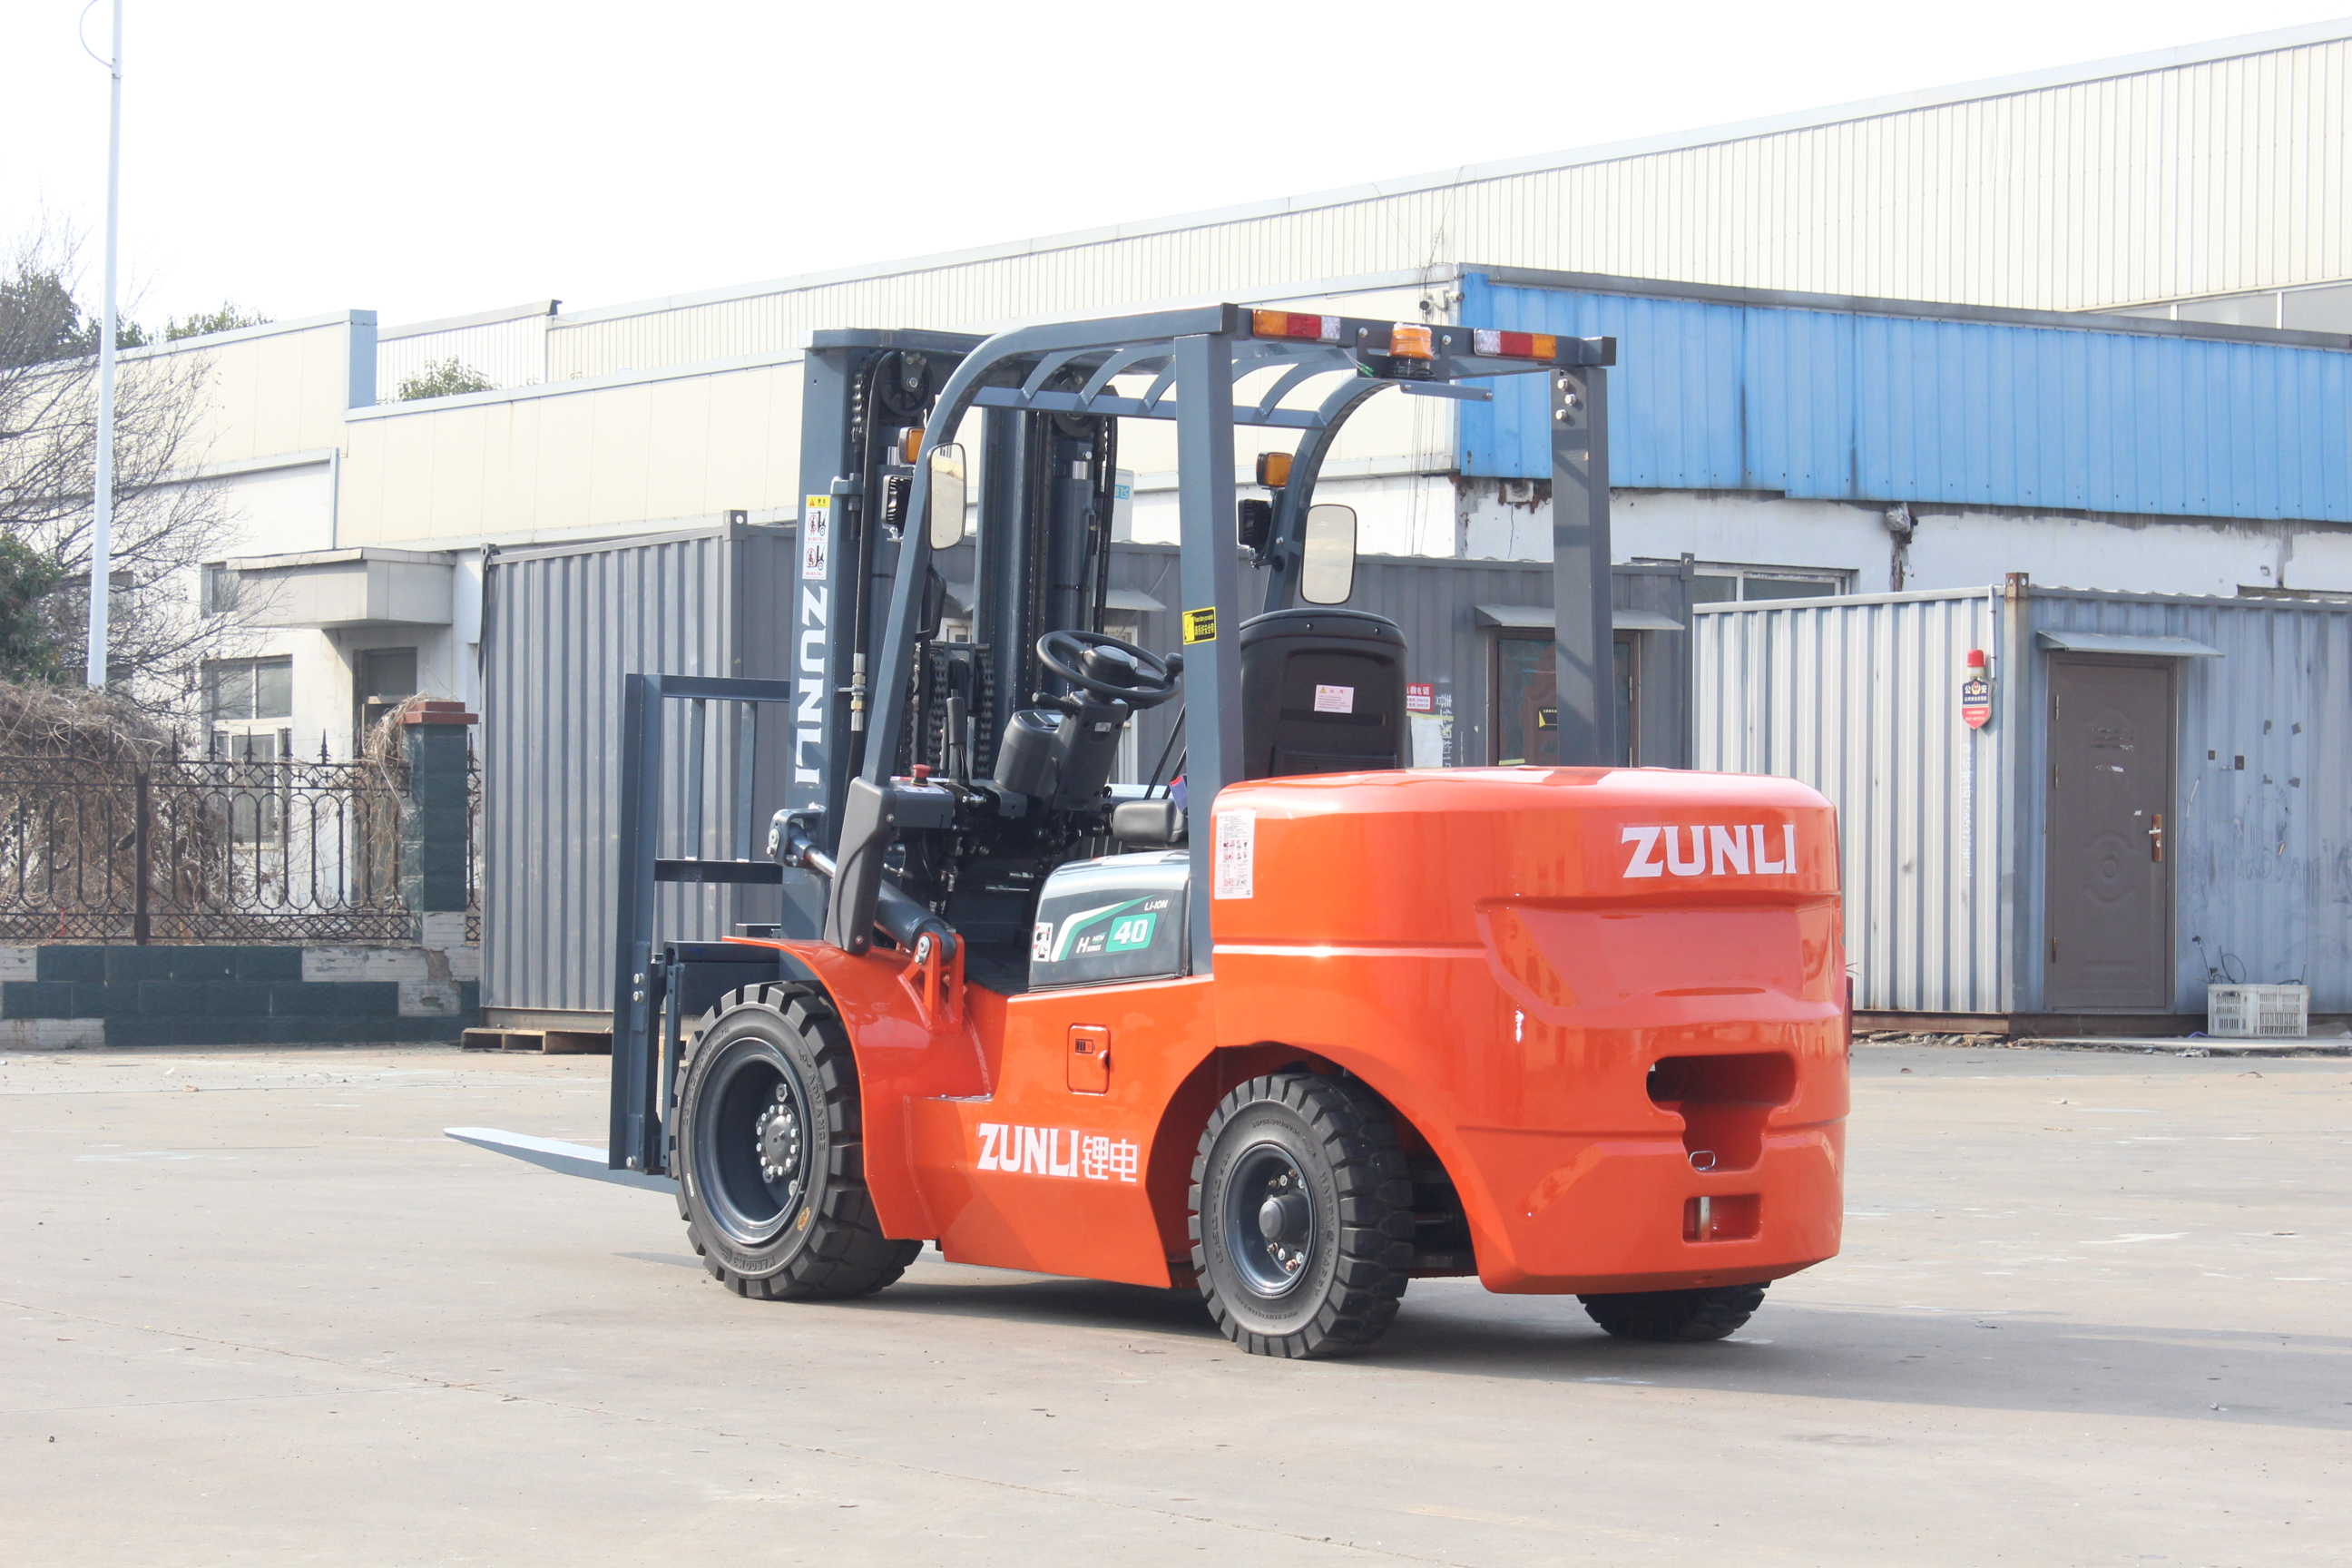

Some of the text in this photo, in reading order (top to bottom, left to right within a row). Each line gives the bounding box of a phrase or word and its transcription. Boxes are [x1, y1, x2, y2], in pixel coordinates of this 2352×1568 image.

[795, 585, 828, 784] ZUNLI
[1407, 685, 1430, 695] 救电话
[1622, 824, 1798, 878] ZUNLI
[1075, 936, 1091, 954] H
[1113, 918, 1149, 945] 40
[977, 1122, 1138, 1182] ZUNLI 锂电
